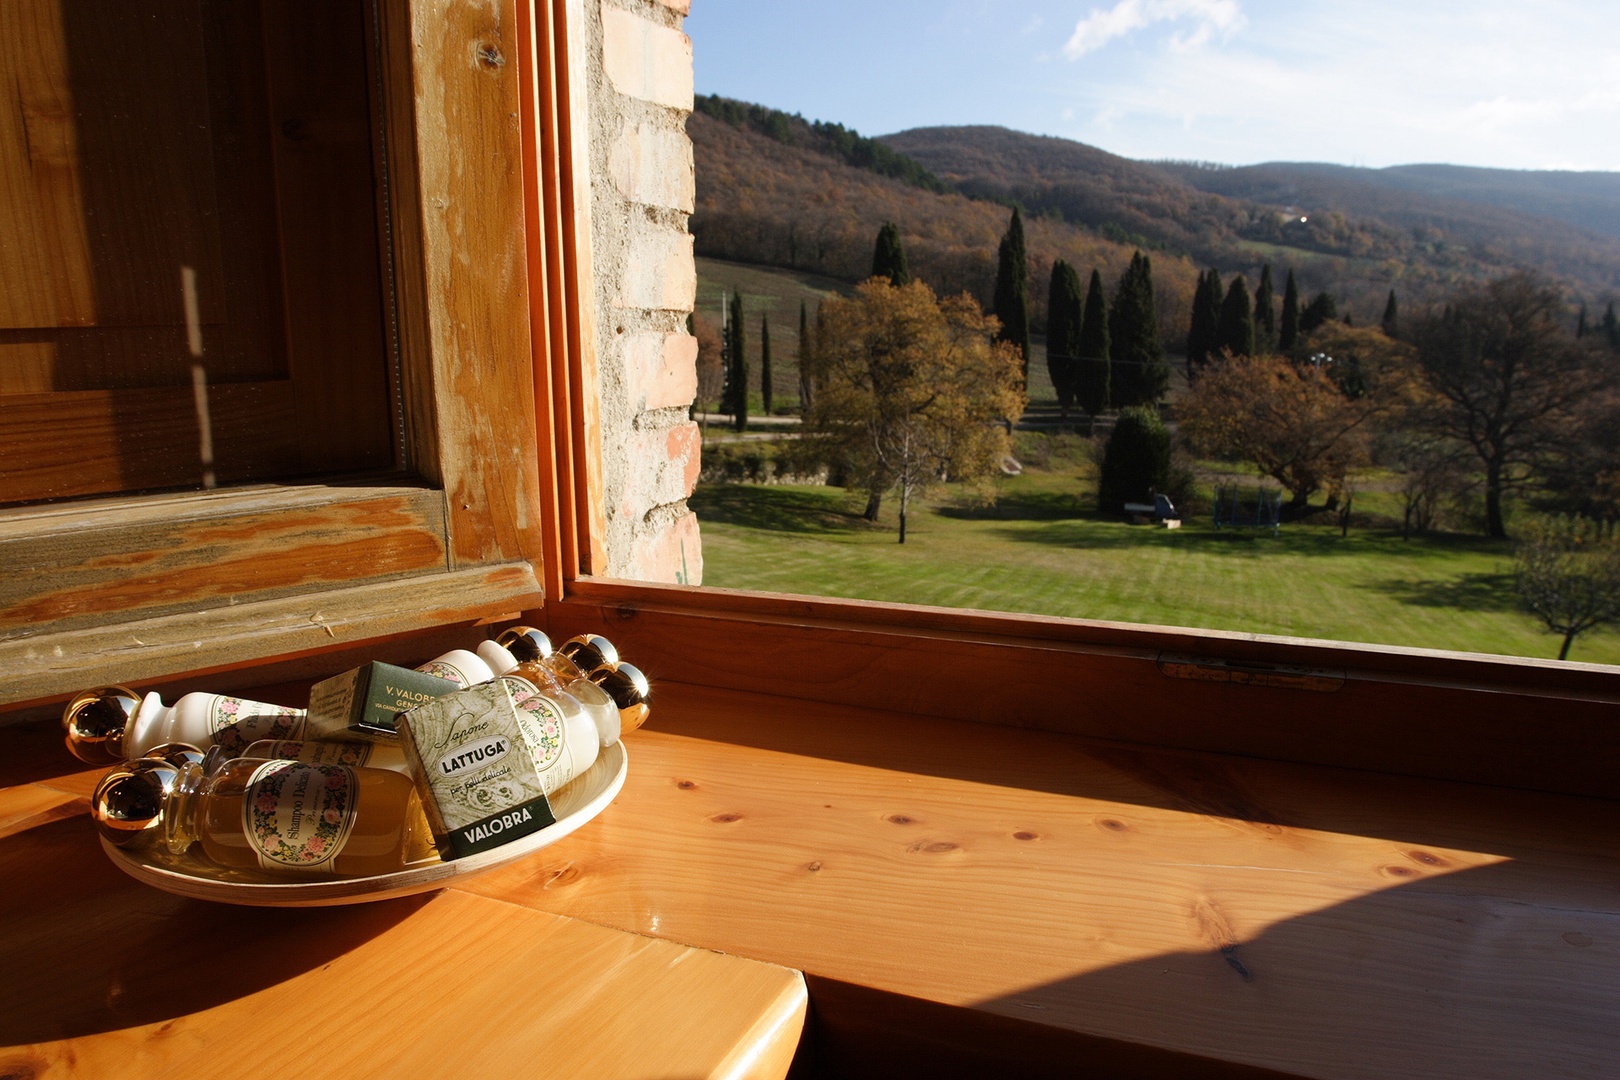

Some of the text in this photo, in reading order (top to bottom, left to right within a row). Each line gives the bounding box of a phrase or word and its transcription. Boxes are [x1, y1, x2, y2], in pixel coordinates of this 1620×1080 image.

[434, 712, 489, 749] Sapone
[450, 784, 463, 798] per
[287, 801, 305, 840] Shampoo
[464, 807, 533, 844] VALOBRA
